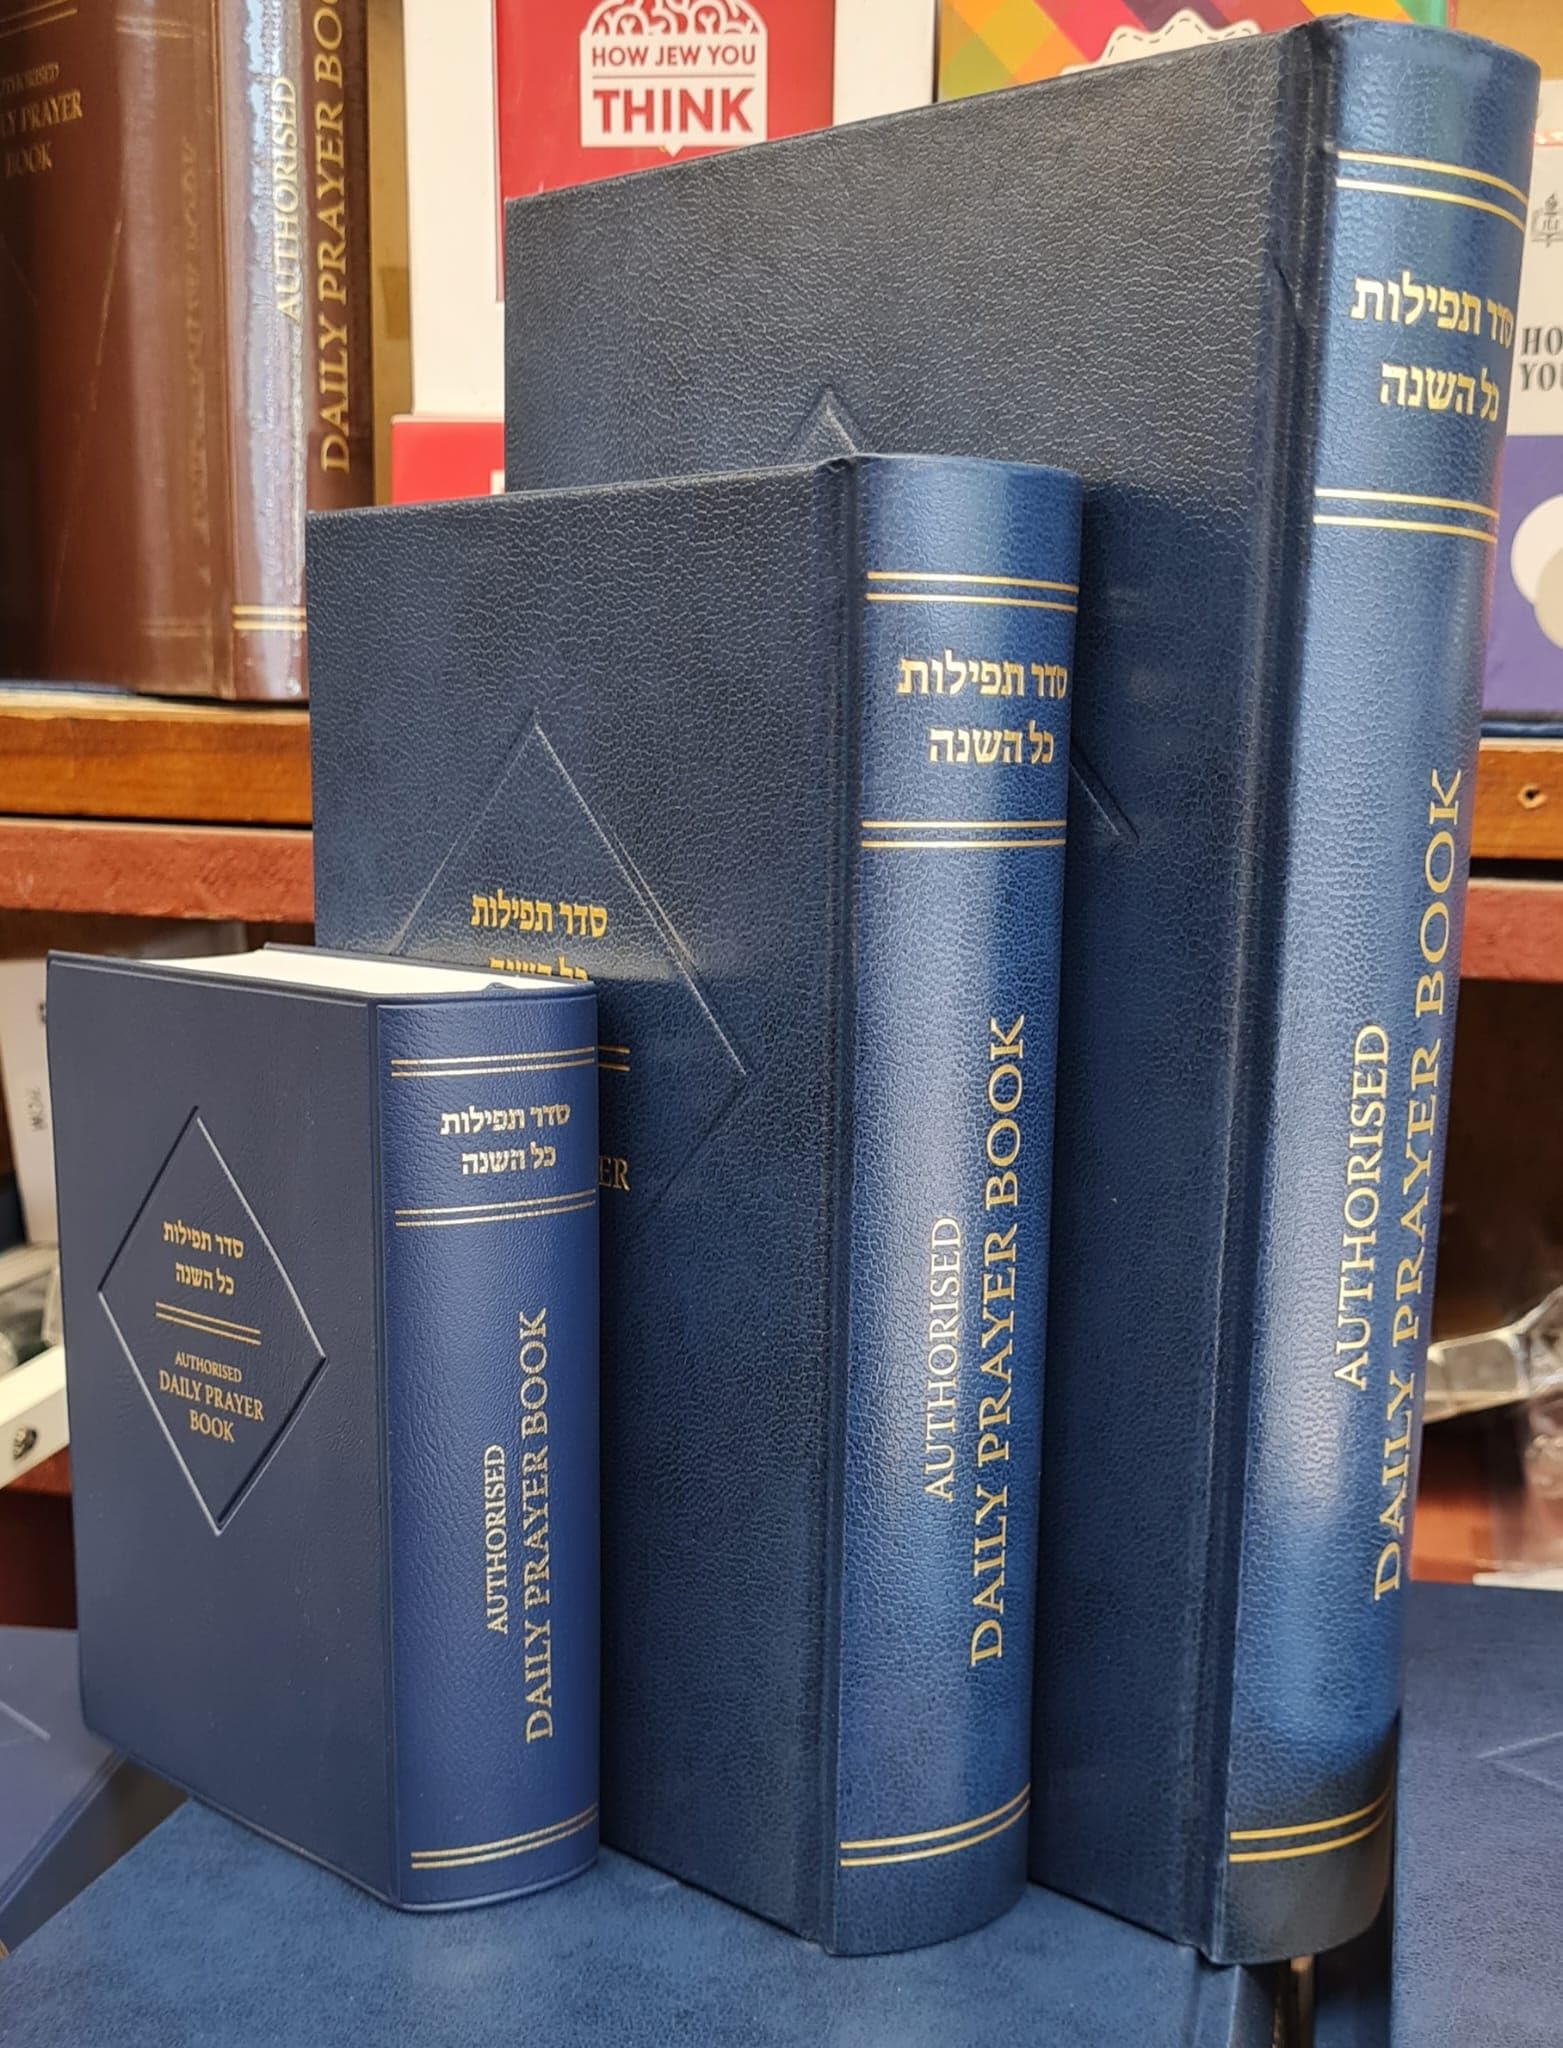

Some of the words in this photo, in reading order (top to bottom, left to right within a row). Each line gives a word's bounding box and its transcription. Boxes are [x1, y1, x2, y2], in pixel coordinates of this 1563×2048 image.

[313, 0, 343, 88] BO
[592, 46, 649, 67] HOW
[655, 46, 701, 66] JEW
[708, 45, 755, 65] YOU
[593, 88, 753, 134] THINK
[271, 75, 301, 322] AUTHORISED
[315, 101, 347, 305] PRAYER
[1350, 271, 1482, 336] תפילות
[1485, 297, 1515, 349] סדר
[317, 312, 349, 474] DAILY
[1380, 363, 1476, 415] השנה
[1480, 368, 1499, 422] כל
[897, 649, 1024, 697] תפילות
[1031, 662, 1067, 699] סדר
[929, 728, 1023, 764] השנה
[1028, 720, 1054, 764] כל
[470, 888, 553, 934] תפילות
[1416, 768, 1461, 1018] BOOK
[559, 901, 608, 938] סדר
[440, 1105, 525, 1135] תפילות
[530, 1104, 570, 1128] סדר
[985, 1015, 1024, 1211] BOOK
[462, 1148, 526, 1175] השנה
[530, 1141, 556, 1169] כל
[1334, 1023, 1389, 1391] AUTHORISED
[1393, 1038, 1440, 1347] PRAYER
[163, 1219, 212, 1252] תפילות
[215, 1233, 244, 1259] סדר
[175, 1262, 213, 1291] השנה
[216, 1268, 235, 1296] כל
[175, 1351, 243, 1383] AUTHORISED
[924, 1216, 961, 1502] AUTHORISED
[977, 1223, 1018, 1467] PRAYER
[159, 1369, 201, 1402] DAILY
[205, 1384, 264, 1421] PRAYER
[519, 1307, 549, 1440] BOOK
[189, 1409, 235, 1443] BOOK
[1374, 1369, 1416, 1600] DAILY
[484, 1443, 509, 1635] AUTHORISED
[521, 1445, 551, 1608] PRAYER
[970, 1485, 1008, 1667] DAILY
[523, 1619, 553, 1744] DAILY
